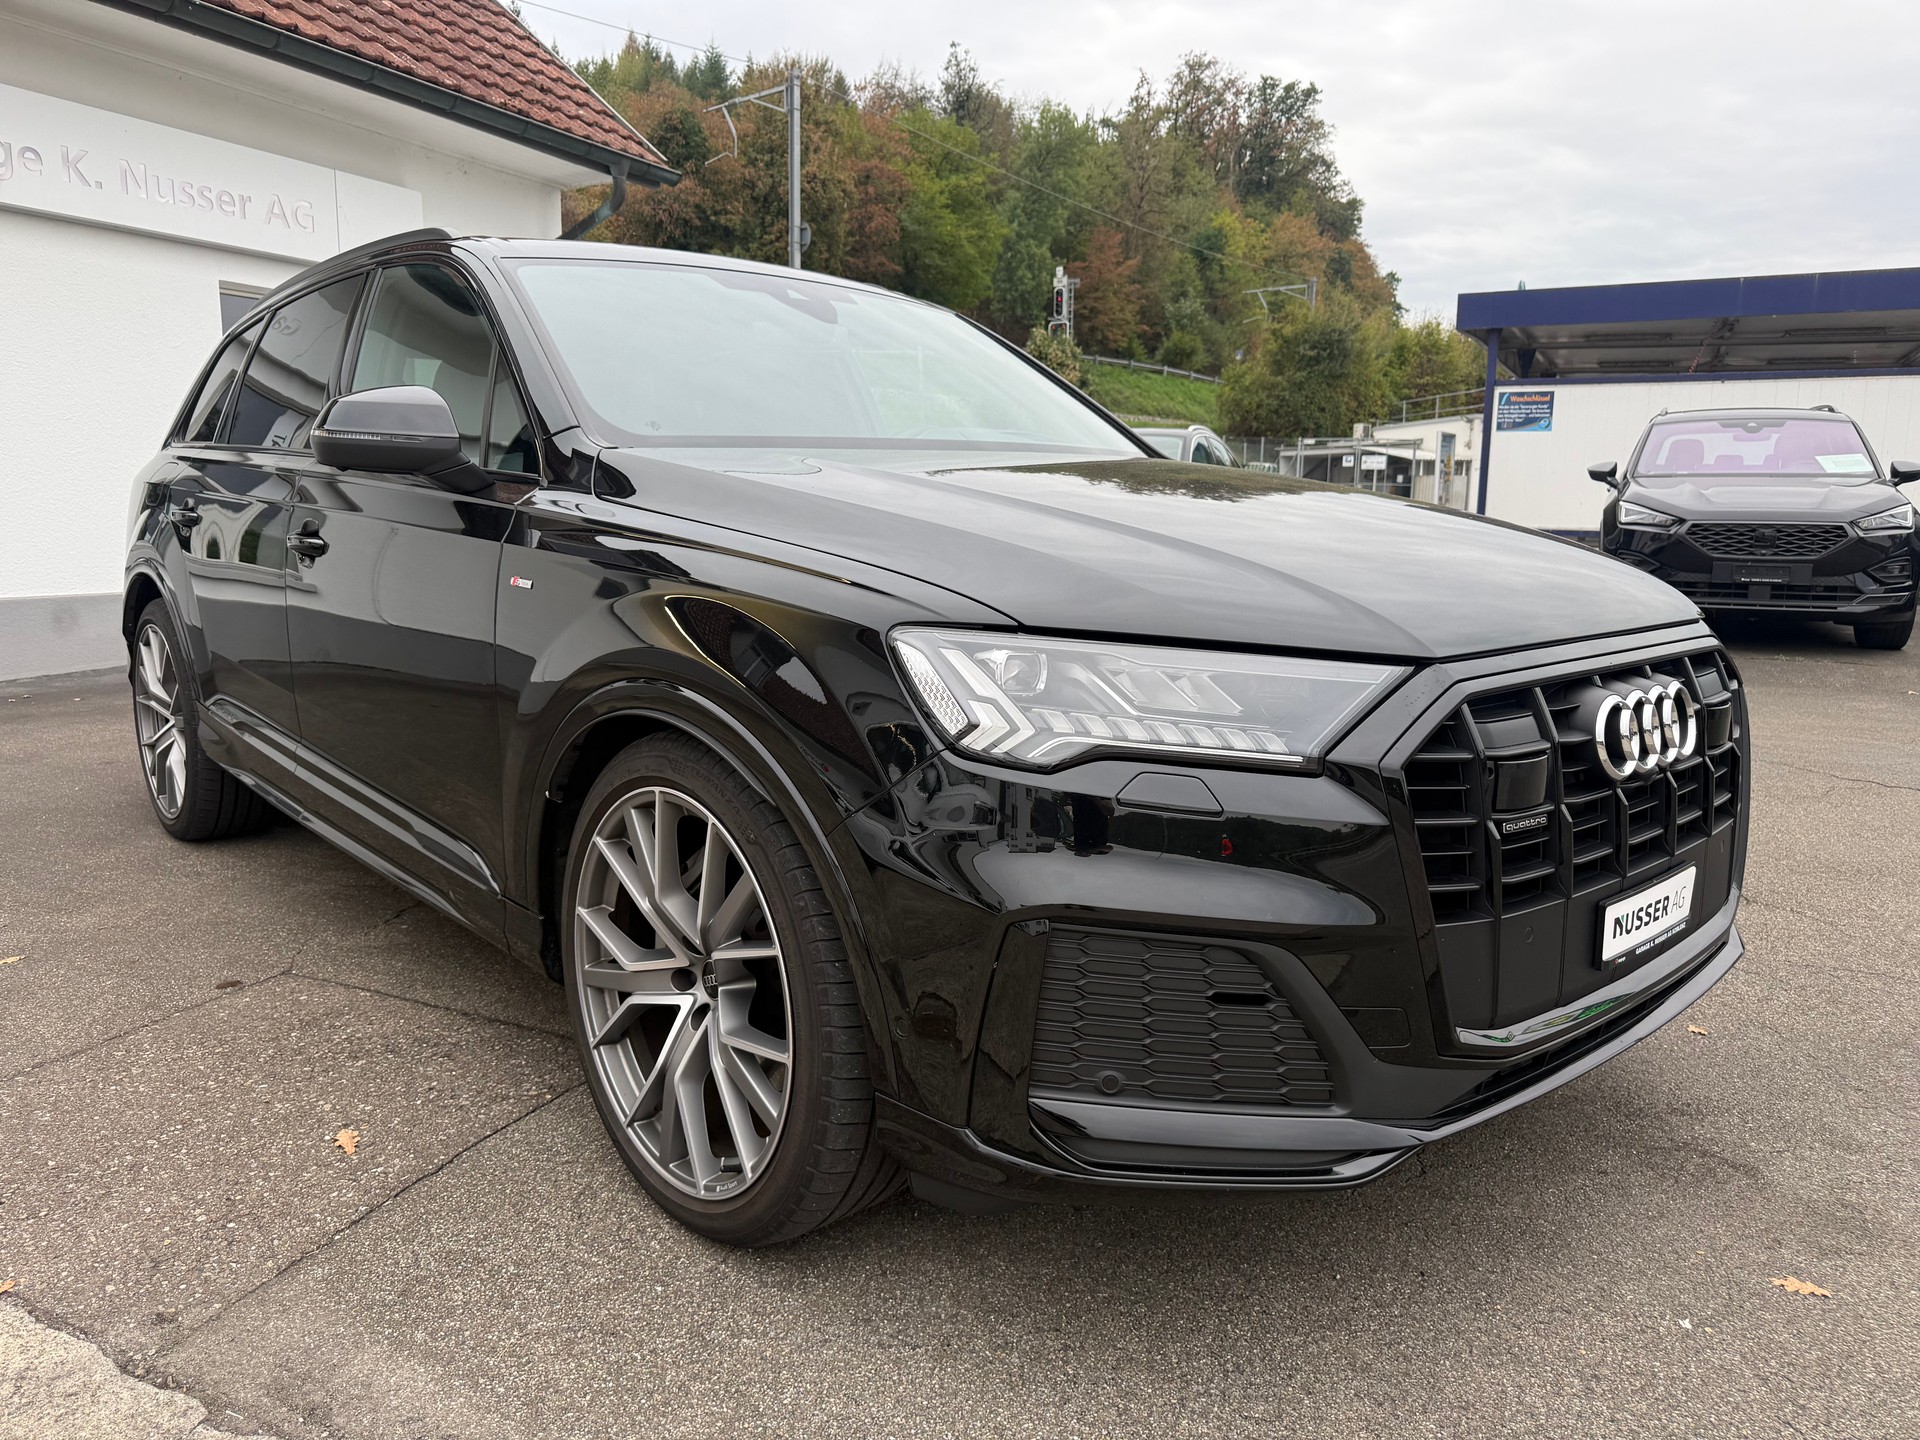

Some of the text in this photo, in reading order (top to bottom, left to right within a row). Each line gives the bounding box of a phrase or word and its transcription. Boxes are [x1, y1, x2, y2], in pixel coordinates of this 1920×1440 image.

[60, 145, 103, 190] K.
[119, 158, 251, 220] Nusser
[264, 193, 315, 233] AG
[1506, 817, 1547, 831] quattro
[1612, 886, 1687, 940] NUSSER AG
